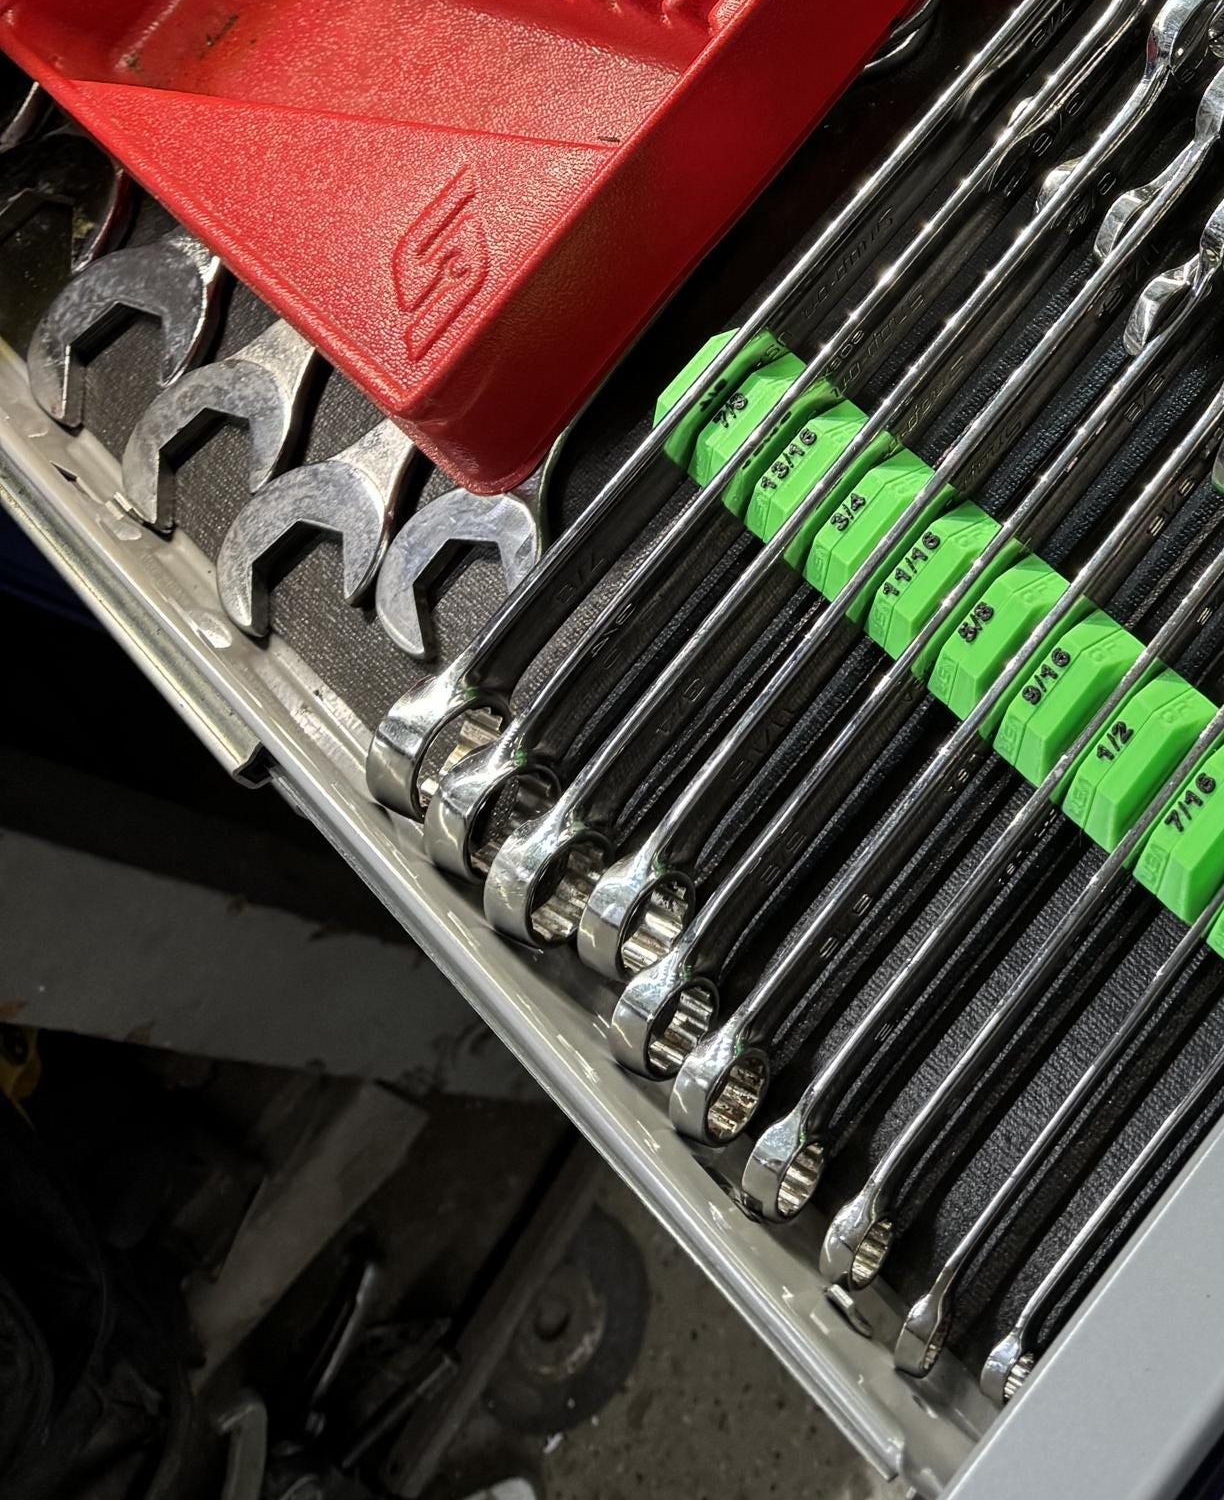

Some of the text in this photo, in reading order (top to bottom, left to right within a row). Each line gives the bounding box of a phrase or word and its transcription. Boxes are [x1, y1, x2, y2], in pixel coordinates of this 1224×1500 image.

[712, 392, 749, 429] 7/8
[760, 428, 817, 491] 13/16
[829, 492, 867, 532] 3/4
[882, 531, 941, 597] 11/16
[956, 600, 996, 644] 5/8
[1021, 646, 1072, 707] 9/16
[1095, 720, 1135, 763] 1/2
[1163, 771, 1218, 834] 7/16
